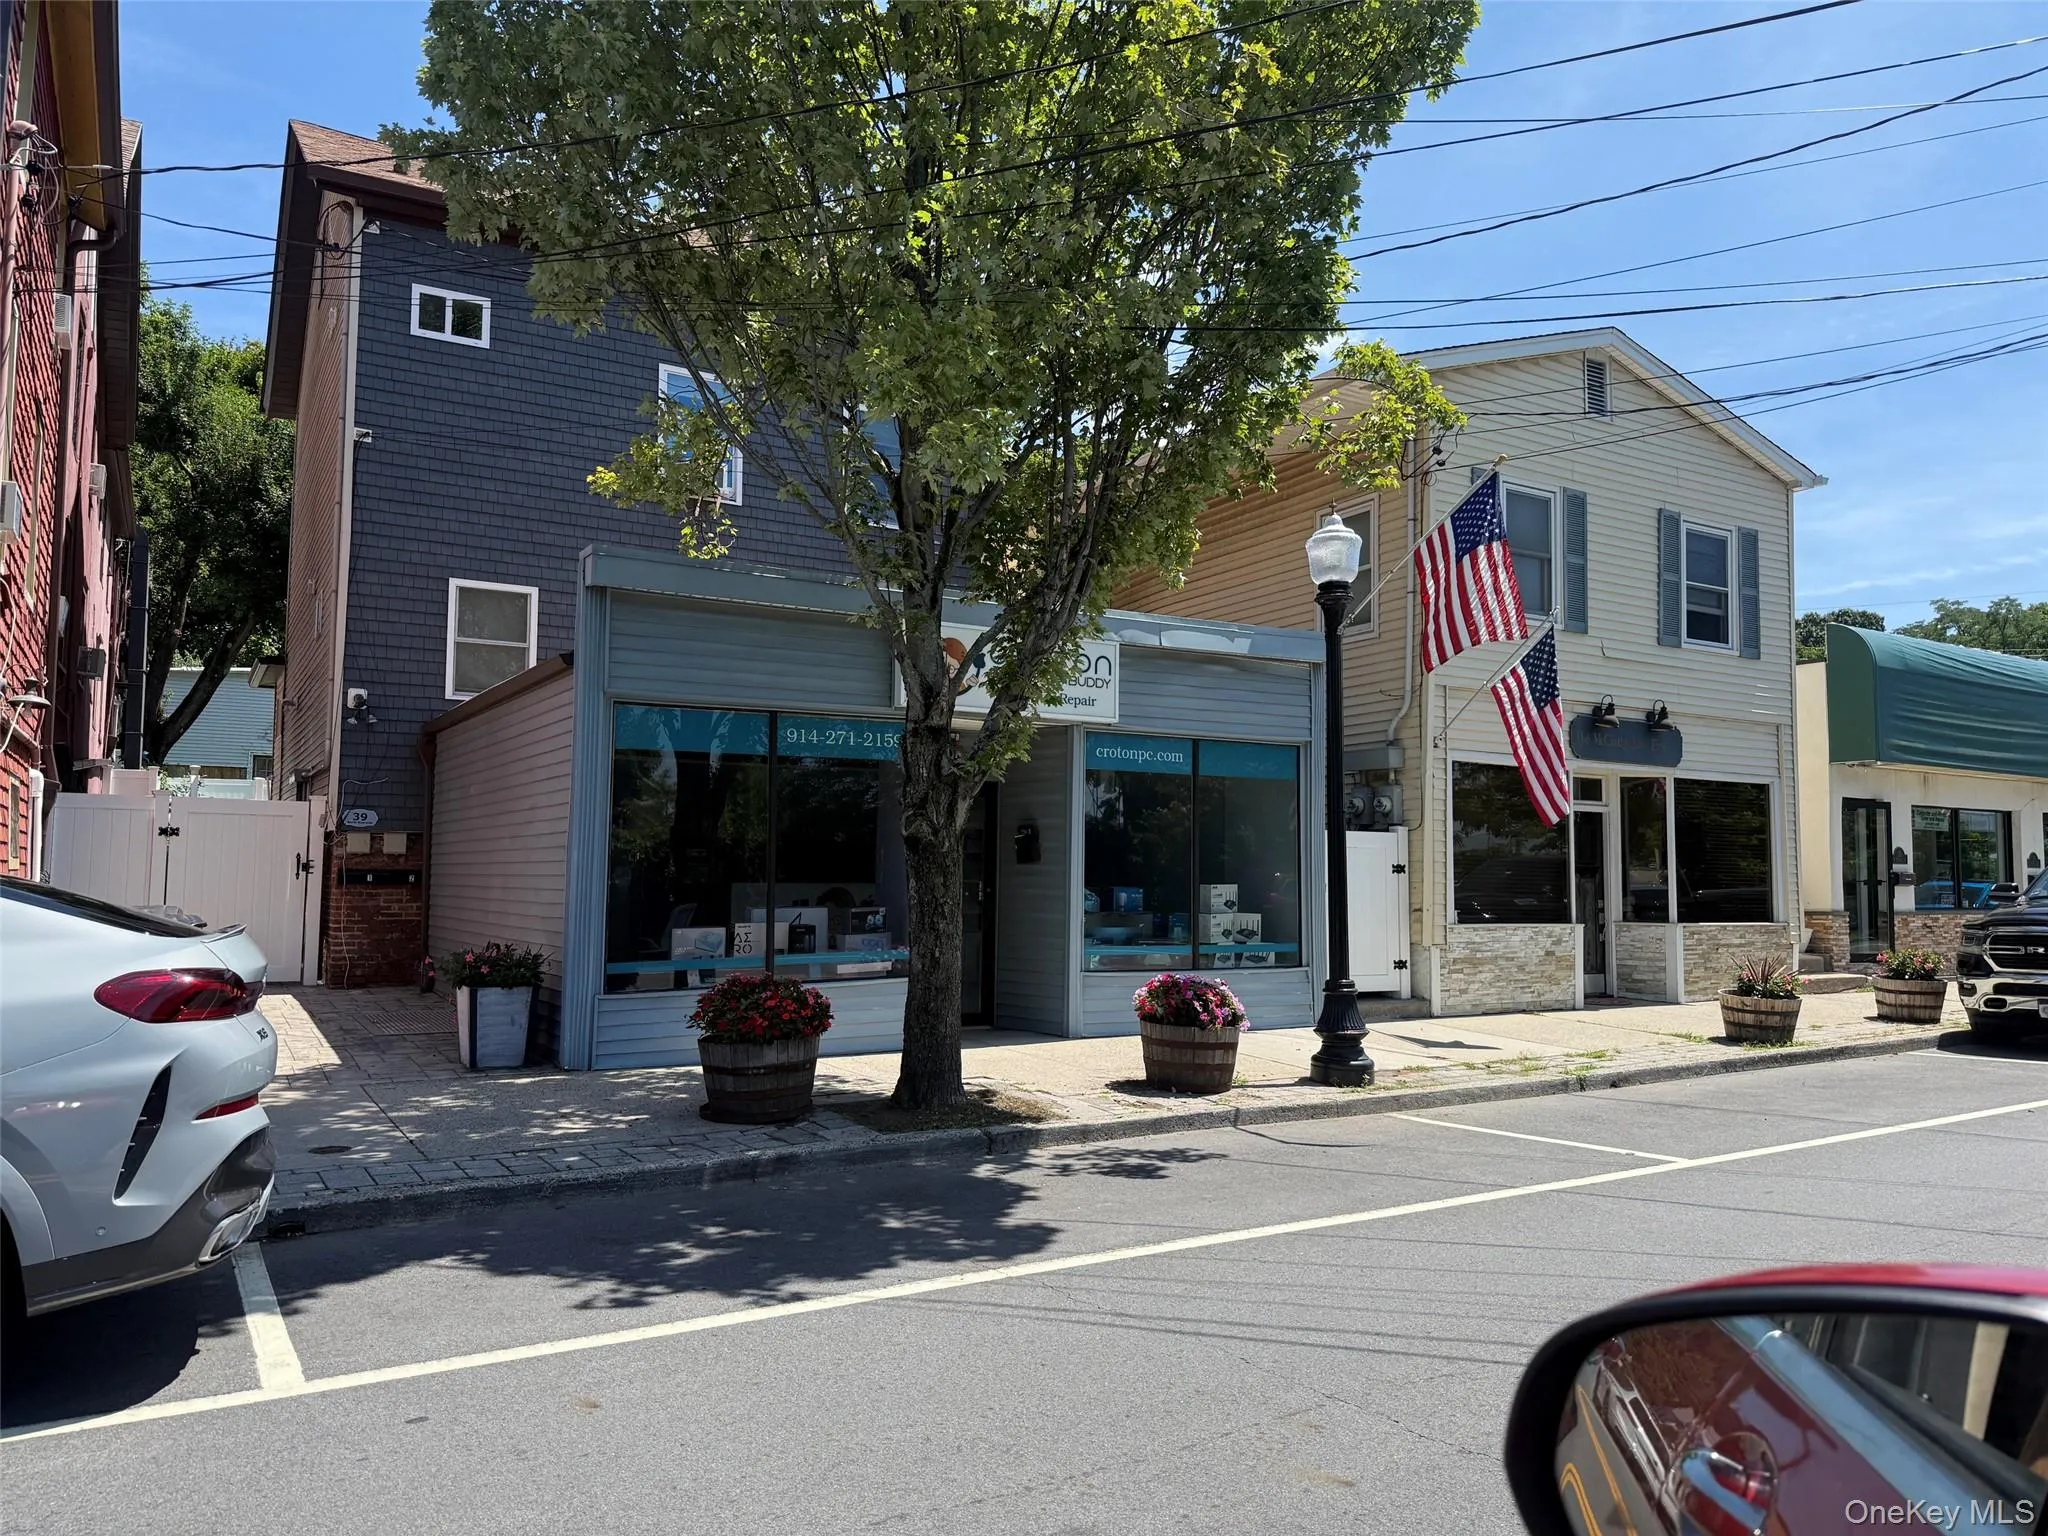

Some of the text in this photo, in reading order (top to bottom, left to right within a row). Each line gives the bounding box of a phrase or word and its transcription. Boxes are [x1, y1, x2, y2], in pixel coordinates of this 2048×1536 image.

[1068, 676, 1112, 689] BUDDY
[1059, 692, 1097, 708] Repair
[1096, 746, 1184, 763] crotonpc.com
[352, 812, 368, 821] 39
